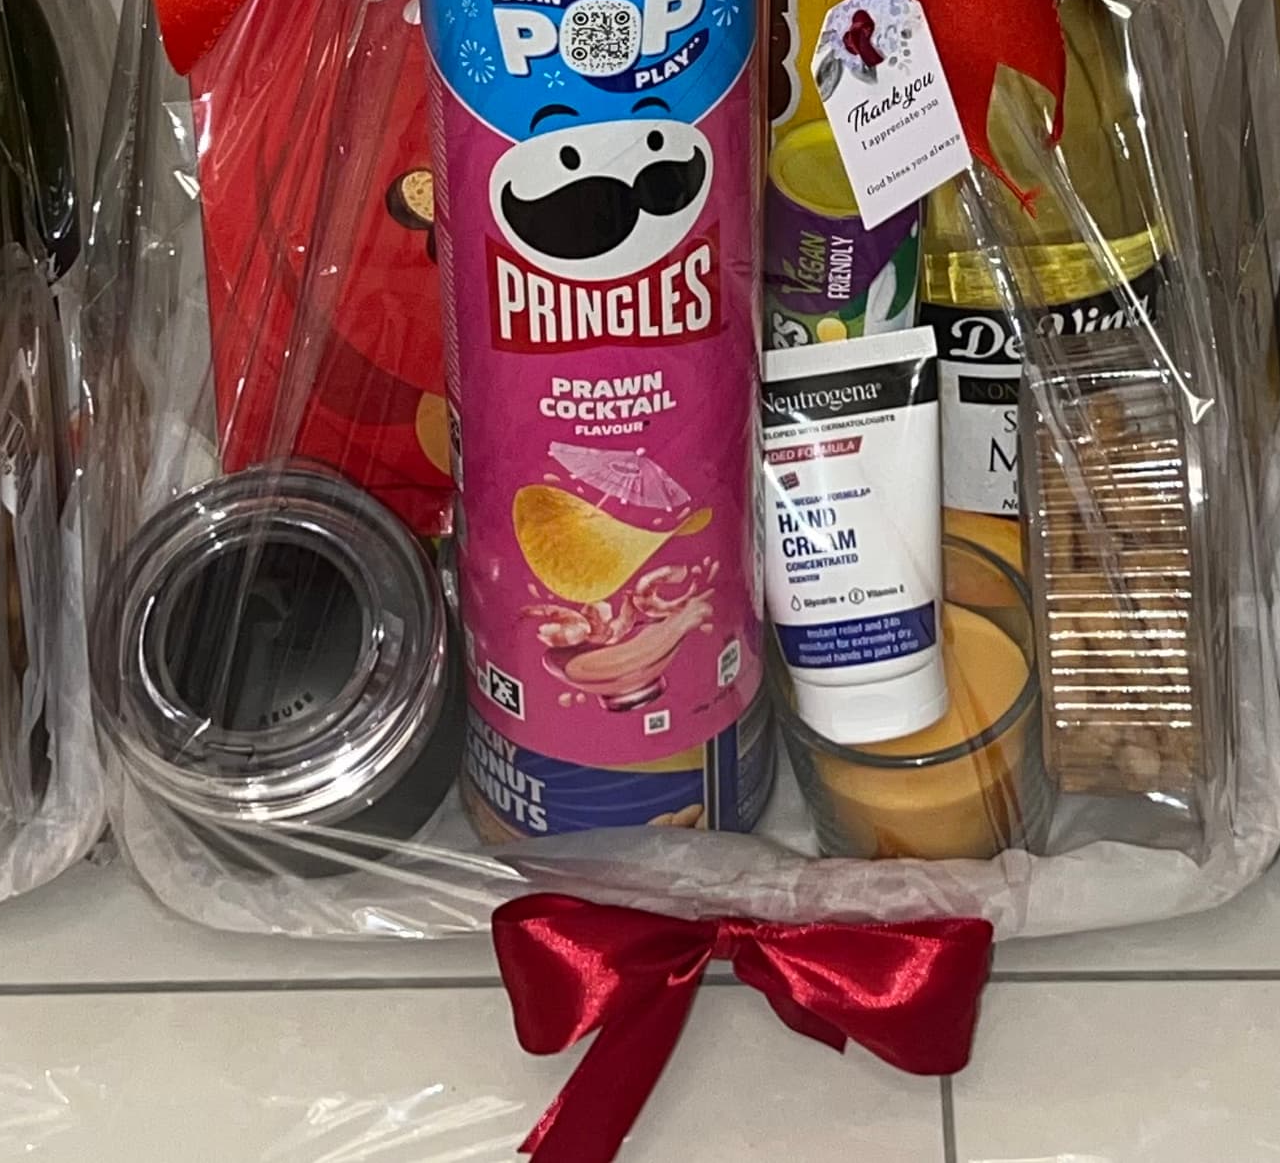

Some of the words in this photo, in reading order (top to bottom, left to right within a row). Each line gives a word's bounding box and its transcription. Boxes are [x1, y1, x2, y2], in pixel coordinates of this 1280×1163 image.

[847, 85, 903, 133] Thank
[901, 70, 935, 110] you
[860, 139, 868, 151] I
[868, 109, 921, 148] appreciate
[920, 97, 940, 116] you
[866, 178, 887, 197] God
[885, 165, 911, 184] bless
[911, 153, 929, 171] you
[929, 133, 962, 158] always
[781, 229, 827, 294] VEGAN
[827, 235, 855, 300] FRIENDLY
[496, 243, 713, 344] PRINGLES
[948, 316, 1025, 360] De
[551, 370, 663, 399] PRAWN
[762, 382, 878, 414] Neutrogena
[539, 389, 677, 421] COCKTAIL
[574, 421, 644, 437] FLAVOUR
[777, 507, 837, 535] HAND
[785, 553, 859, 573] CONCENTRATED
[806, 627, 837, 638] Instant
[838, 623, 863, 636] relief
[864, 620, 882, 632] and
[836, 638, 850, 650] for
[851, 630, 897, 649] extremely
[833, 649, 862, 663] hands
[874, 643, 892, 658] just
